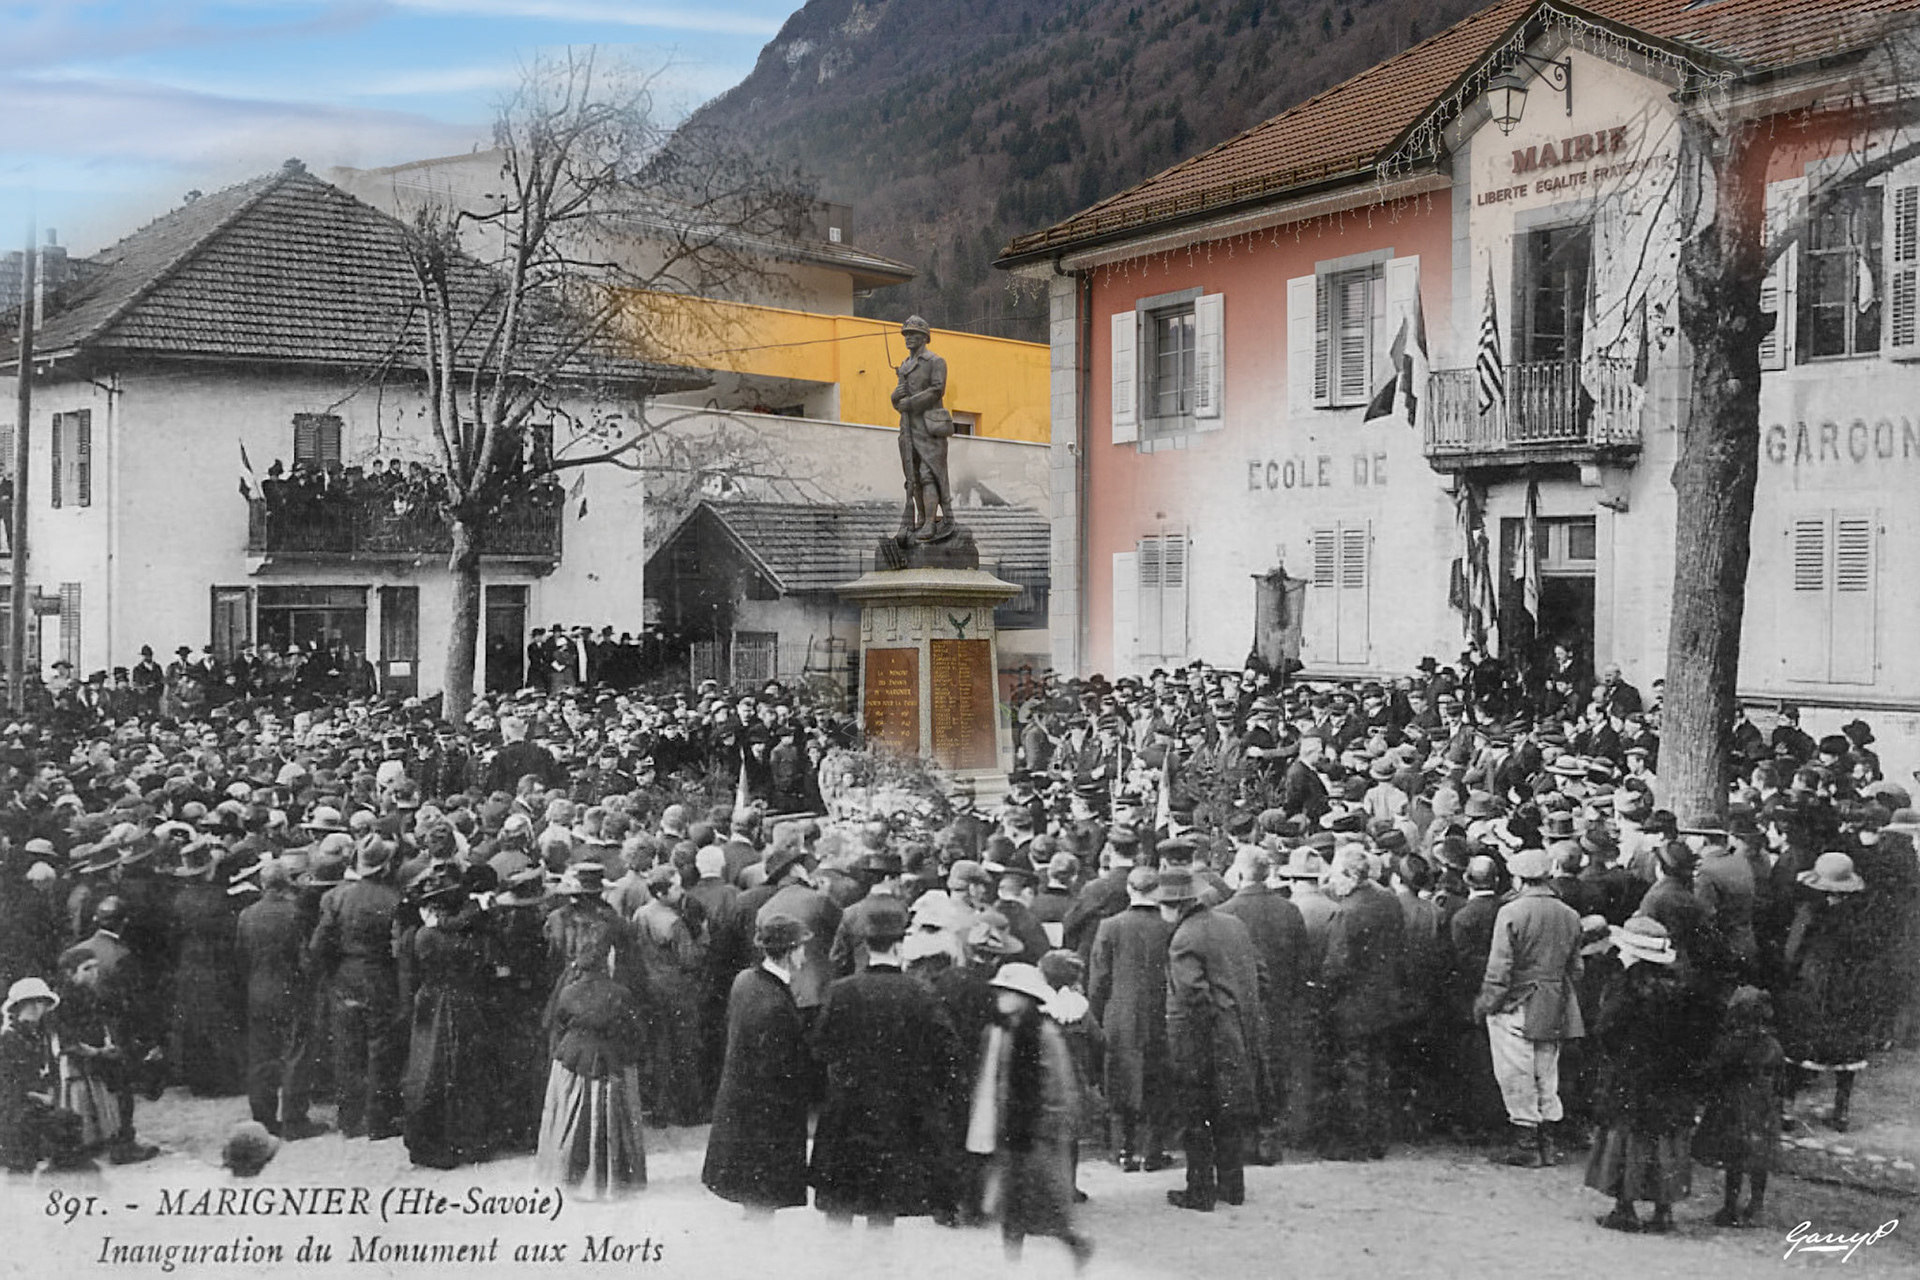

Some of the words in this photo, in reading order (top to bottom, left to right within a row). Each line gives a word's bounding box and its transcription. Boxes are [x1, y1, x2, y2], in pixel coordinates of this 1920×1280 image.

[1511, 125, 1628, 175] MAIRIE
[1477, 183, 1529, 207] LIBERTE
[1535, 171, 1588, 194] EGALITE
[1248, 455, 1331, 490] ECOLE
[1353, 452, 1388, 486] DE
